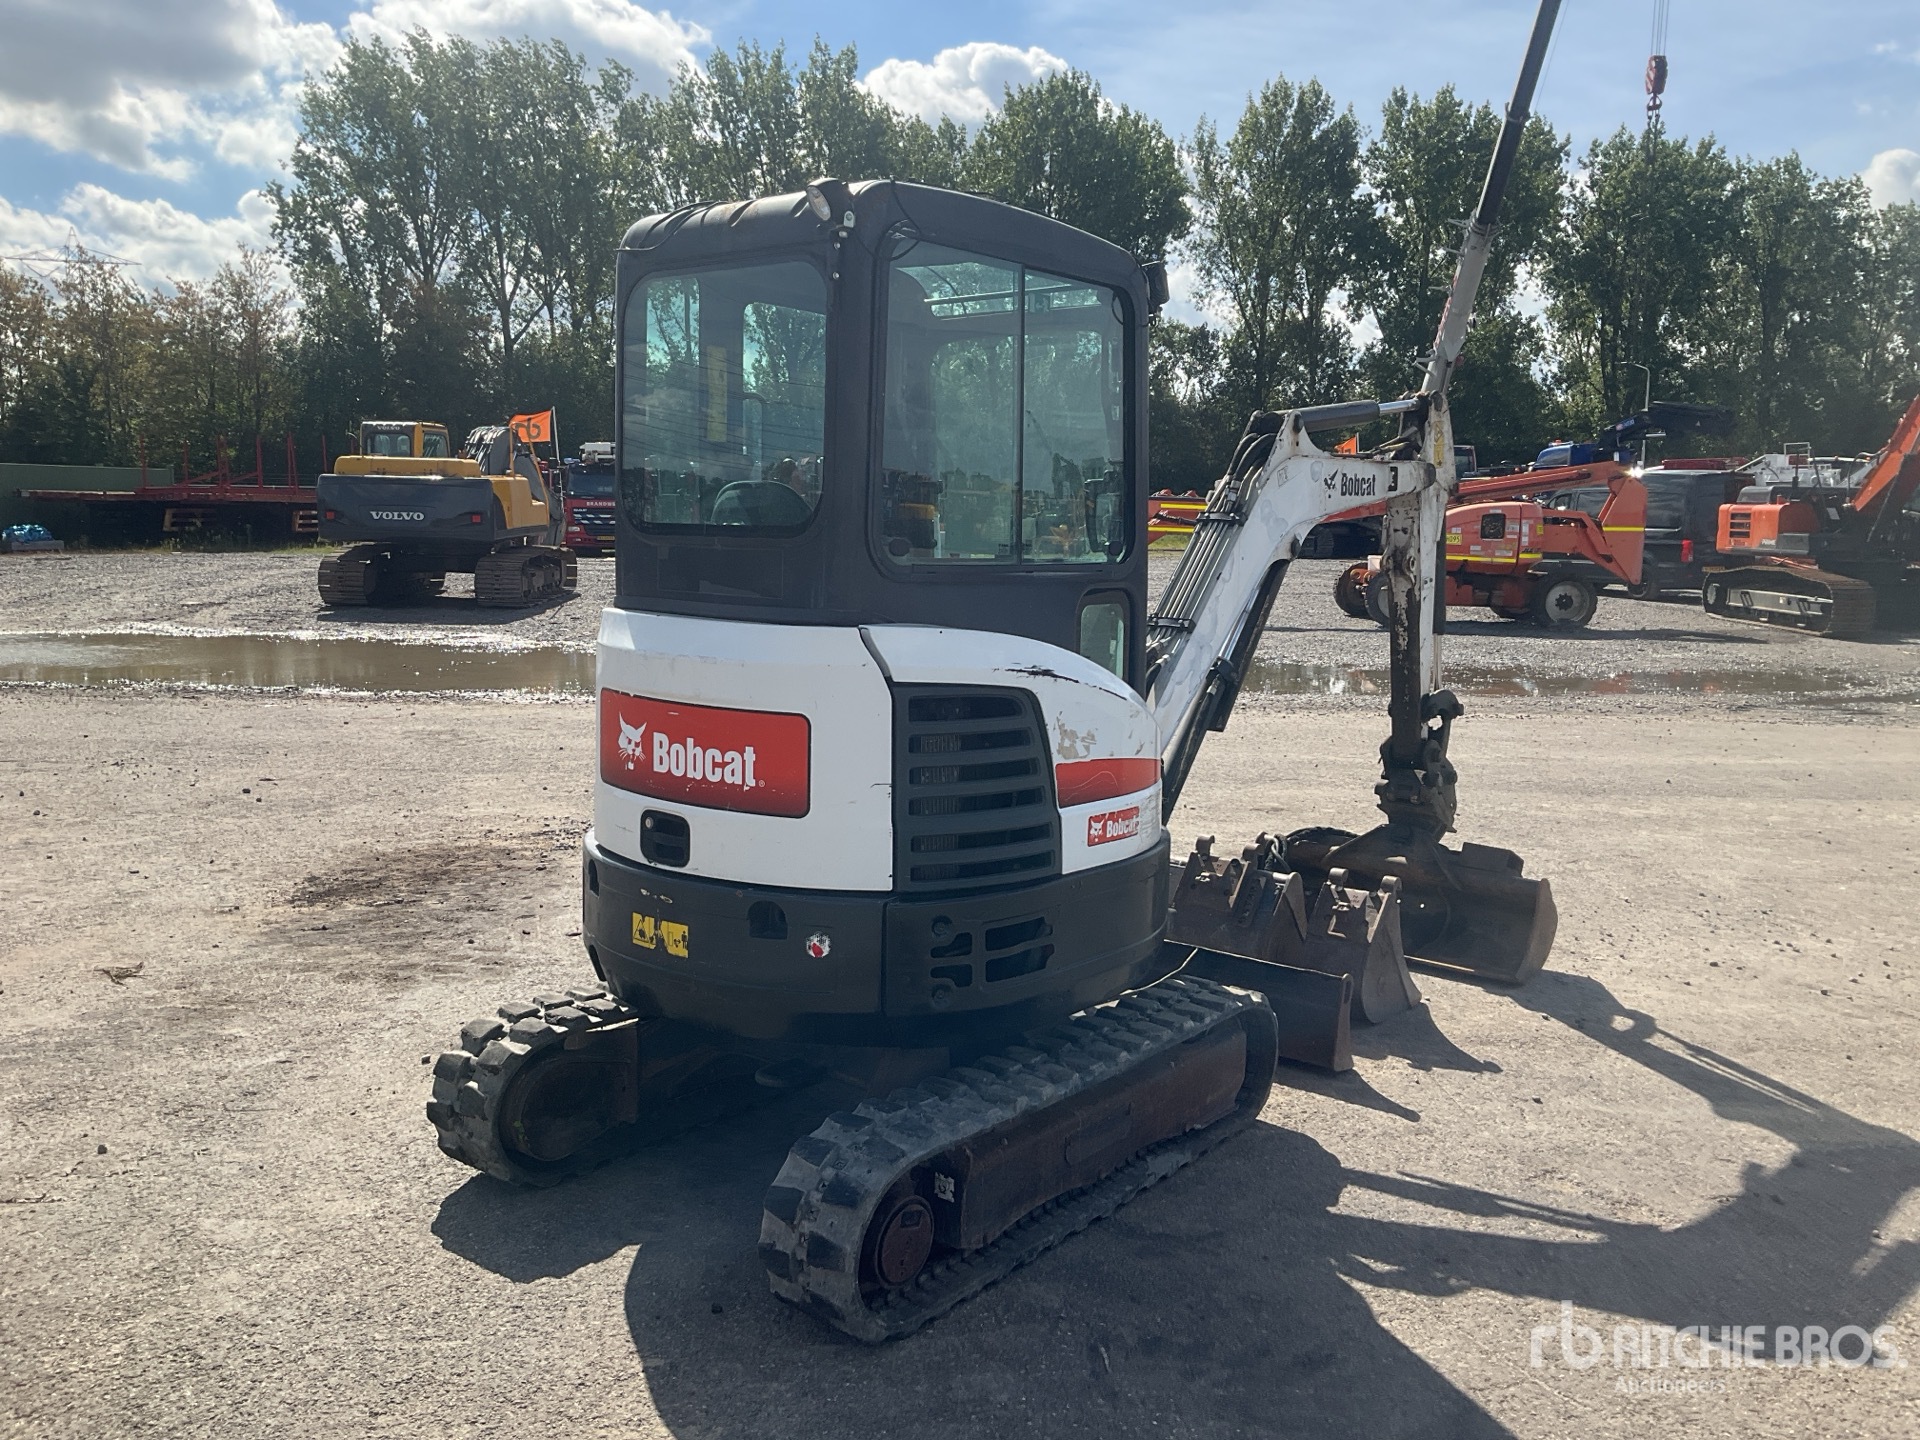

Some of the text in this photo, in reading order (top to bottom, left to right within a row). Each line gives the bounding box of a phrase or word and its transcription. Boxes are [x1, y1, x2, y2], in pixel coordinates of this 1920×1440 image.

[1341, 473, 1376, 496] Bobcat
[370, 511, 424, 520] VOLVO
[653, 731, 756, 787] Bobcat
